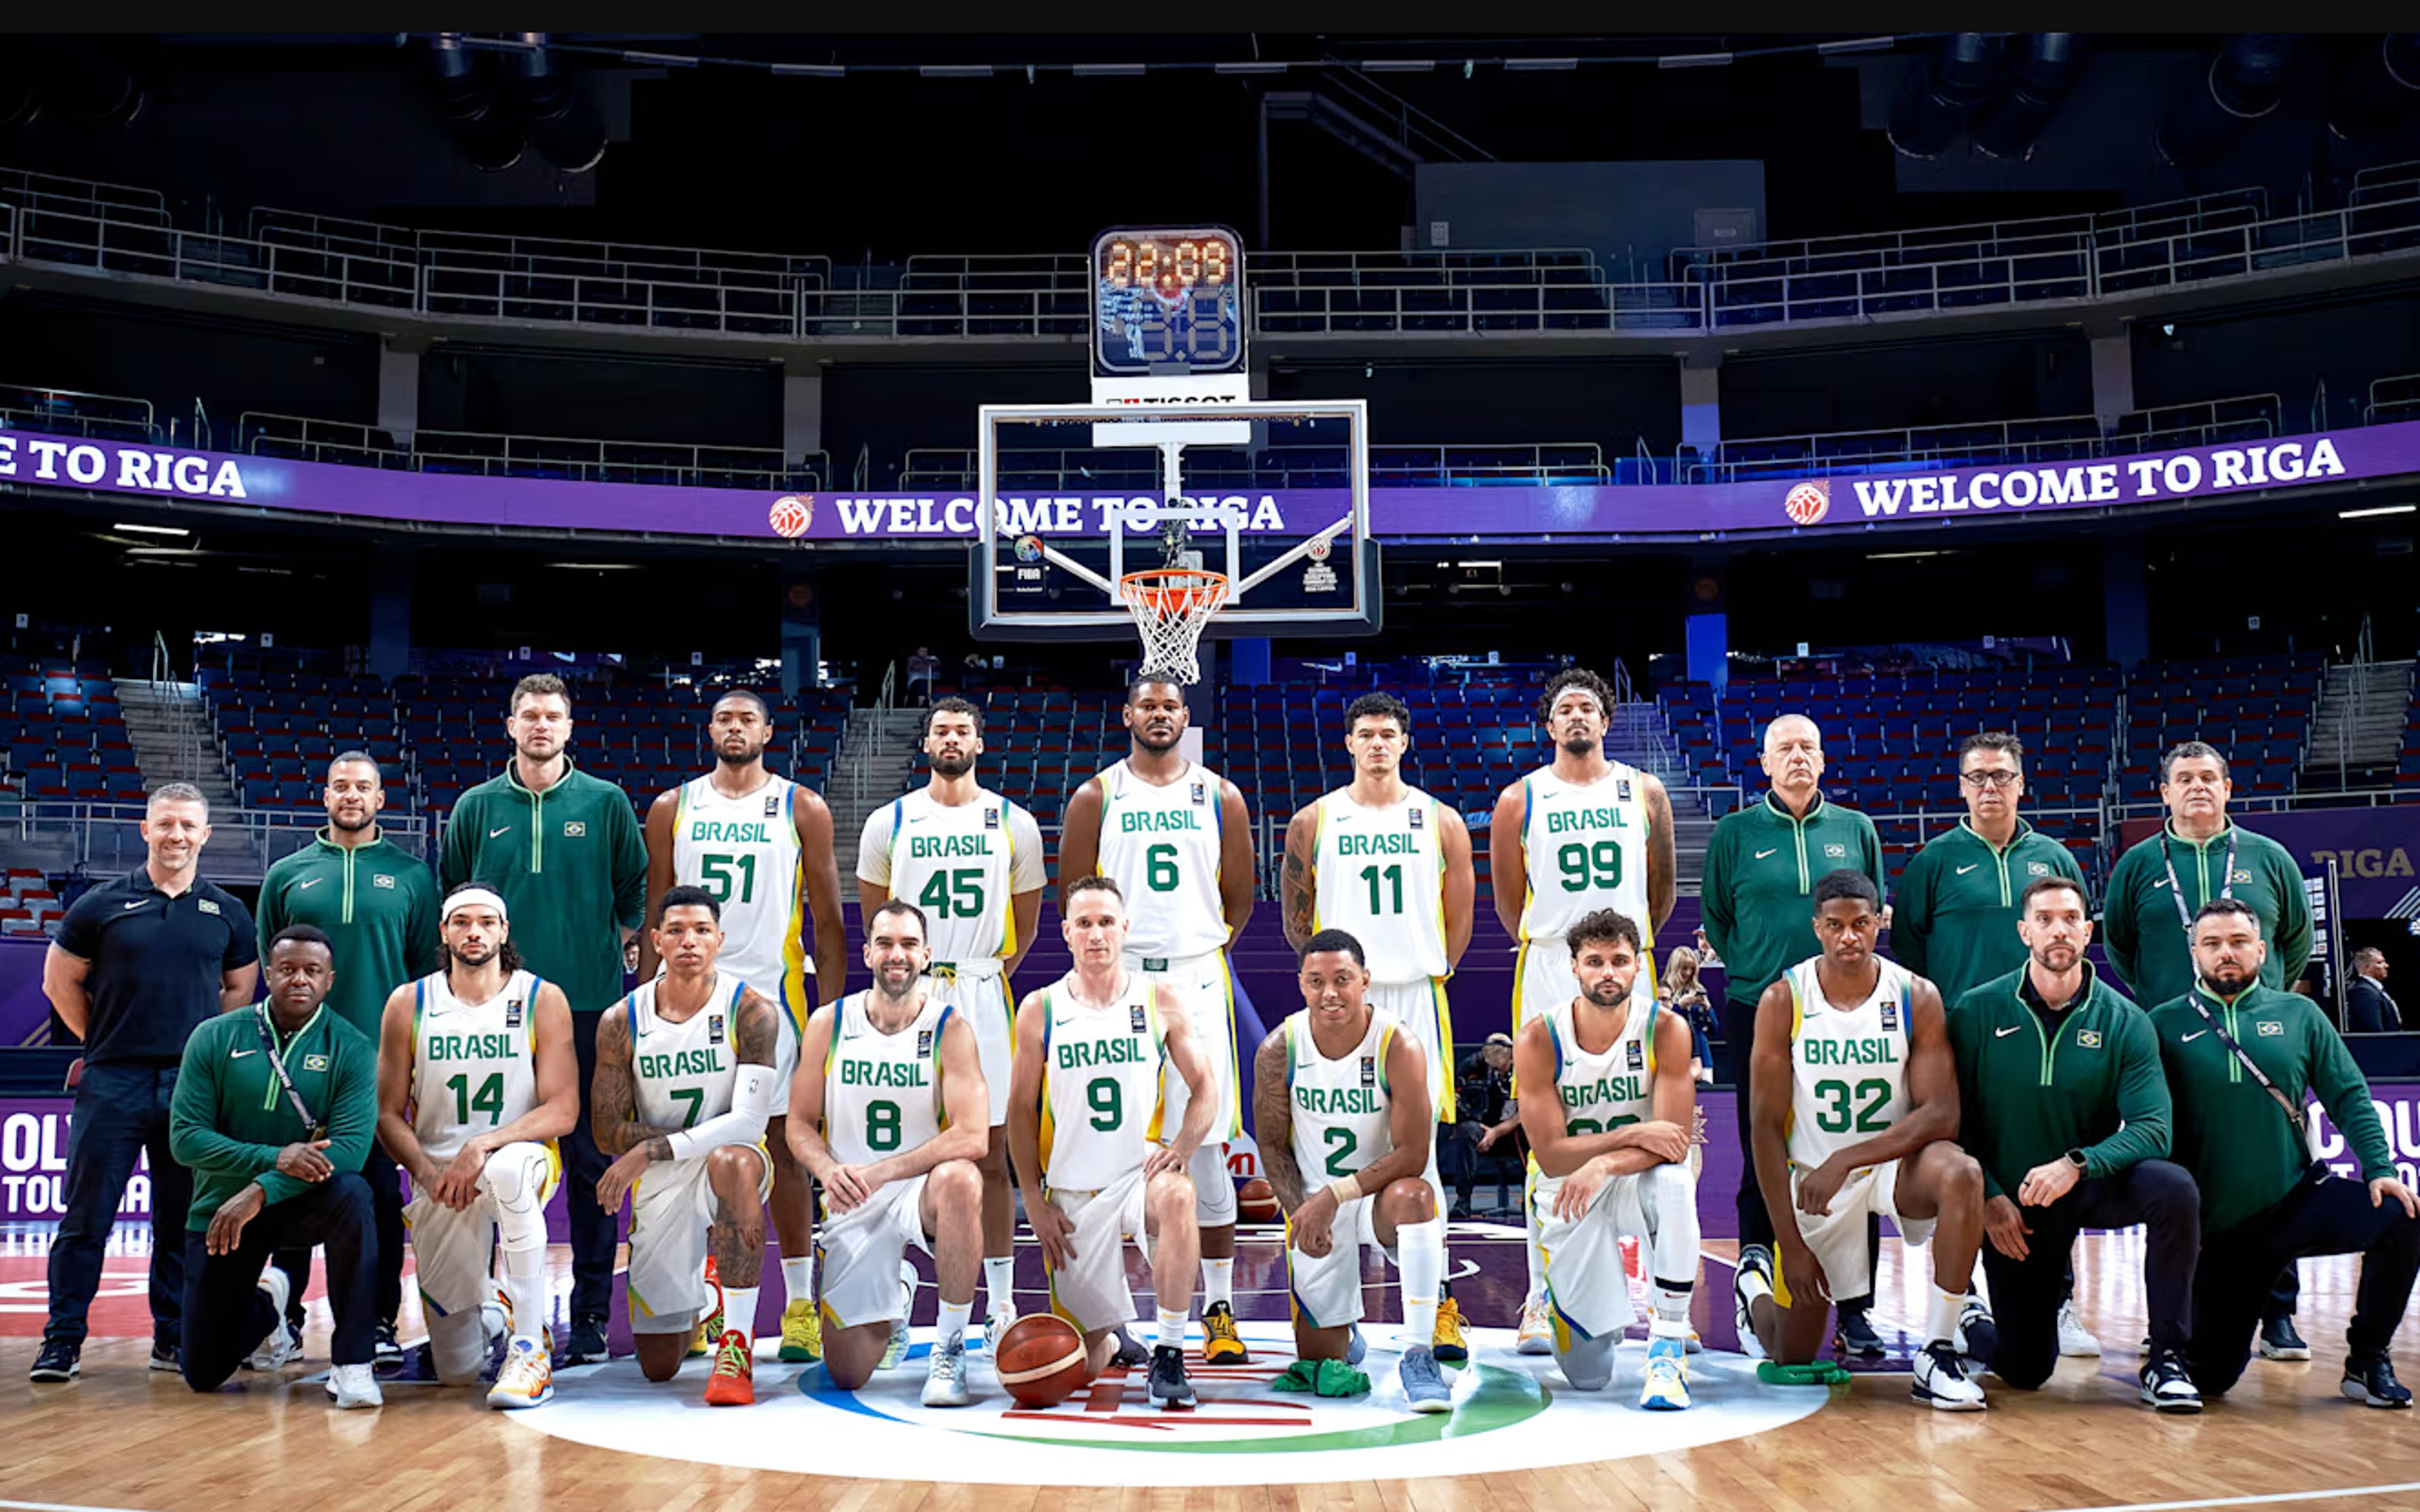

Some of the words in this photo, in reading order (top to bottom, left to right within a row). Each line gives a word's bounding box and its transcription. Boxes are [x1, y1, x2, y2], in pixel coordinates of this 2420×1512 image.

[1108, 242, 1226, 284] 22:09
[28, 440, 106, 483] TO
[116, 449, 247, 498] RIGA
[1853, 464, 2120, 517] WELCOME
[2128, 455, 2202, 496] TO
[2211, 438, 2346, 488] RIGA
[836, 498, 1083, 534] WELCOME
[1092, 496, 1158, 532] TO
[692, 822, 771, 842] BRASIL
[1122, 810, 1201, 832] BRASIL
[1547, 808, 1627, 833] BRASIL
[911, 835, 993, 857] BRASIL
[1339, 833, 1419, 855] BRASIL
[701, 854, 755, 904] 51
[1147, 844, 1179, 891] 6
[1558, 841, 1622, 891] 99
[919, 869, 984, 919] 45
[1361, 865, 1402, 915] 11
[429, 1034, 518, 1060] BRASIL
[639, 1049, 725, 1078] BRASIL
[1058, 1038, 1146, 1069] BRASIL
[1805, 1038, 1898, 1065] BRASIL
[841, 1060, 928, 1087] BRASIL
[1562, 1076, 1644, 1107] BRASIL
[446, 1073, 504, 1126] 14
[670, 1088, 703, 1128] 7
[1087, 1078, 1122, 1131] 9
[1296, 1085, 1382, 1114] BRASIL
[1814, 1078, 1891, 1133] 32
[867, 1100, 901, 1151] 8
[1324, 1127, 1357, 1177] 2
